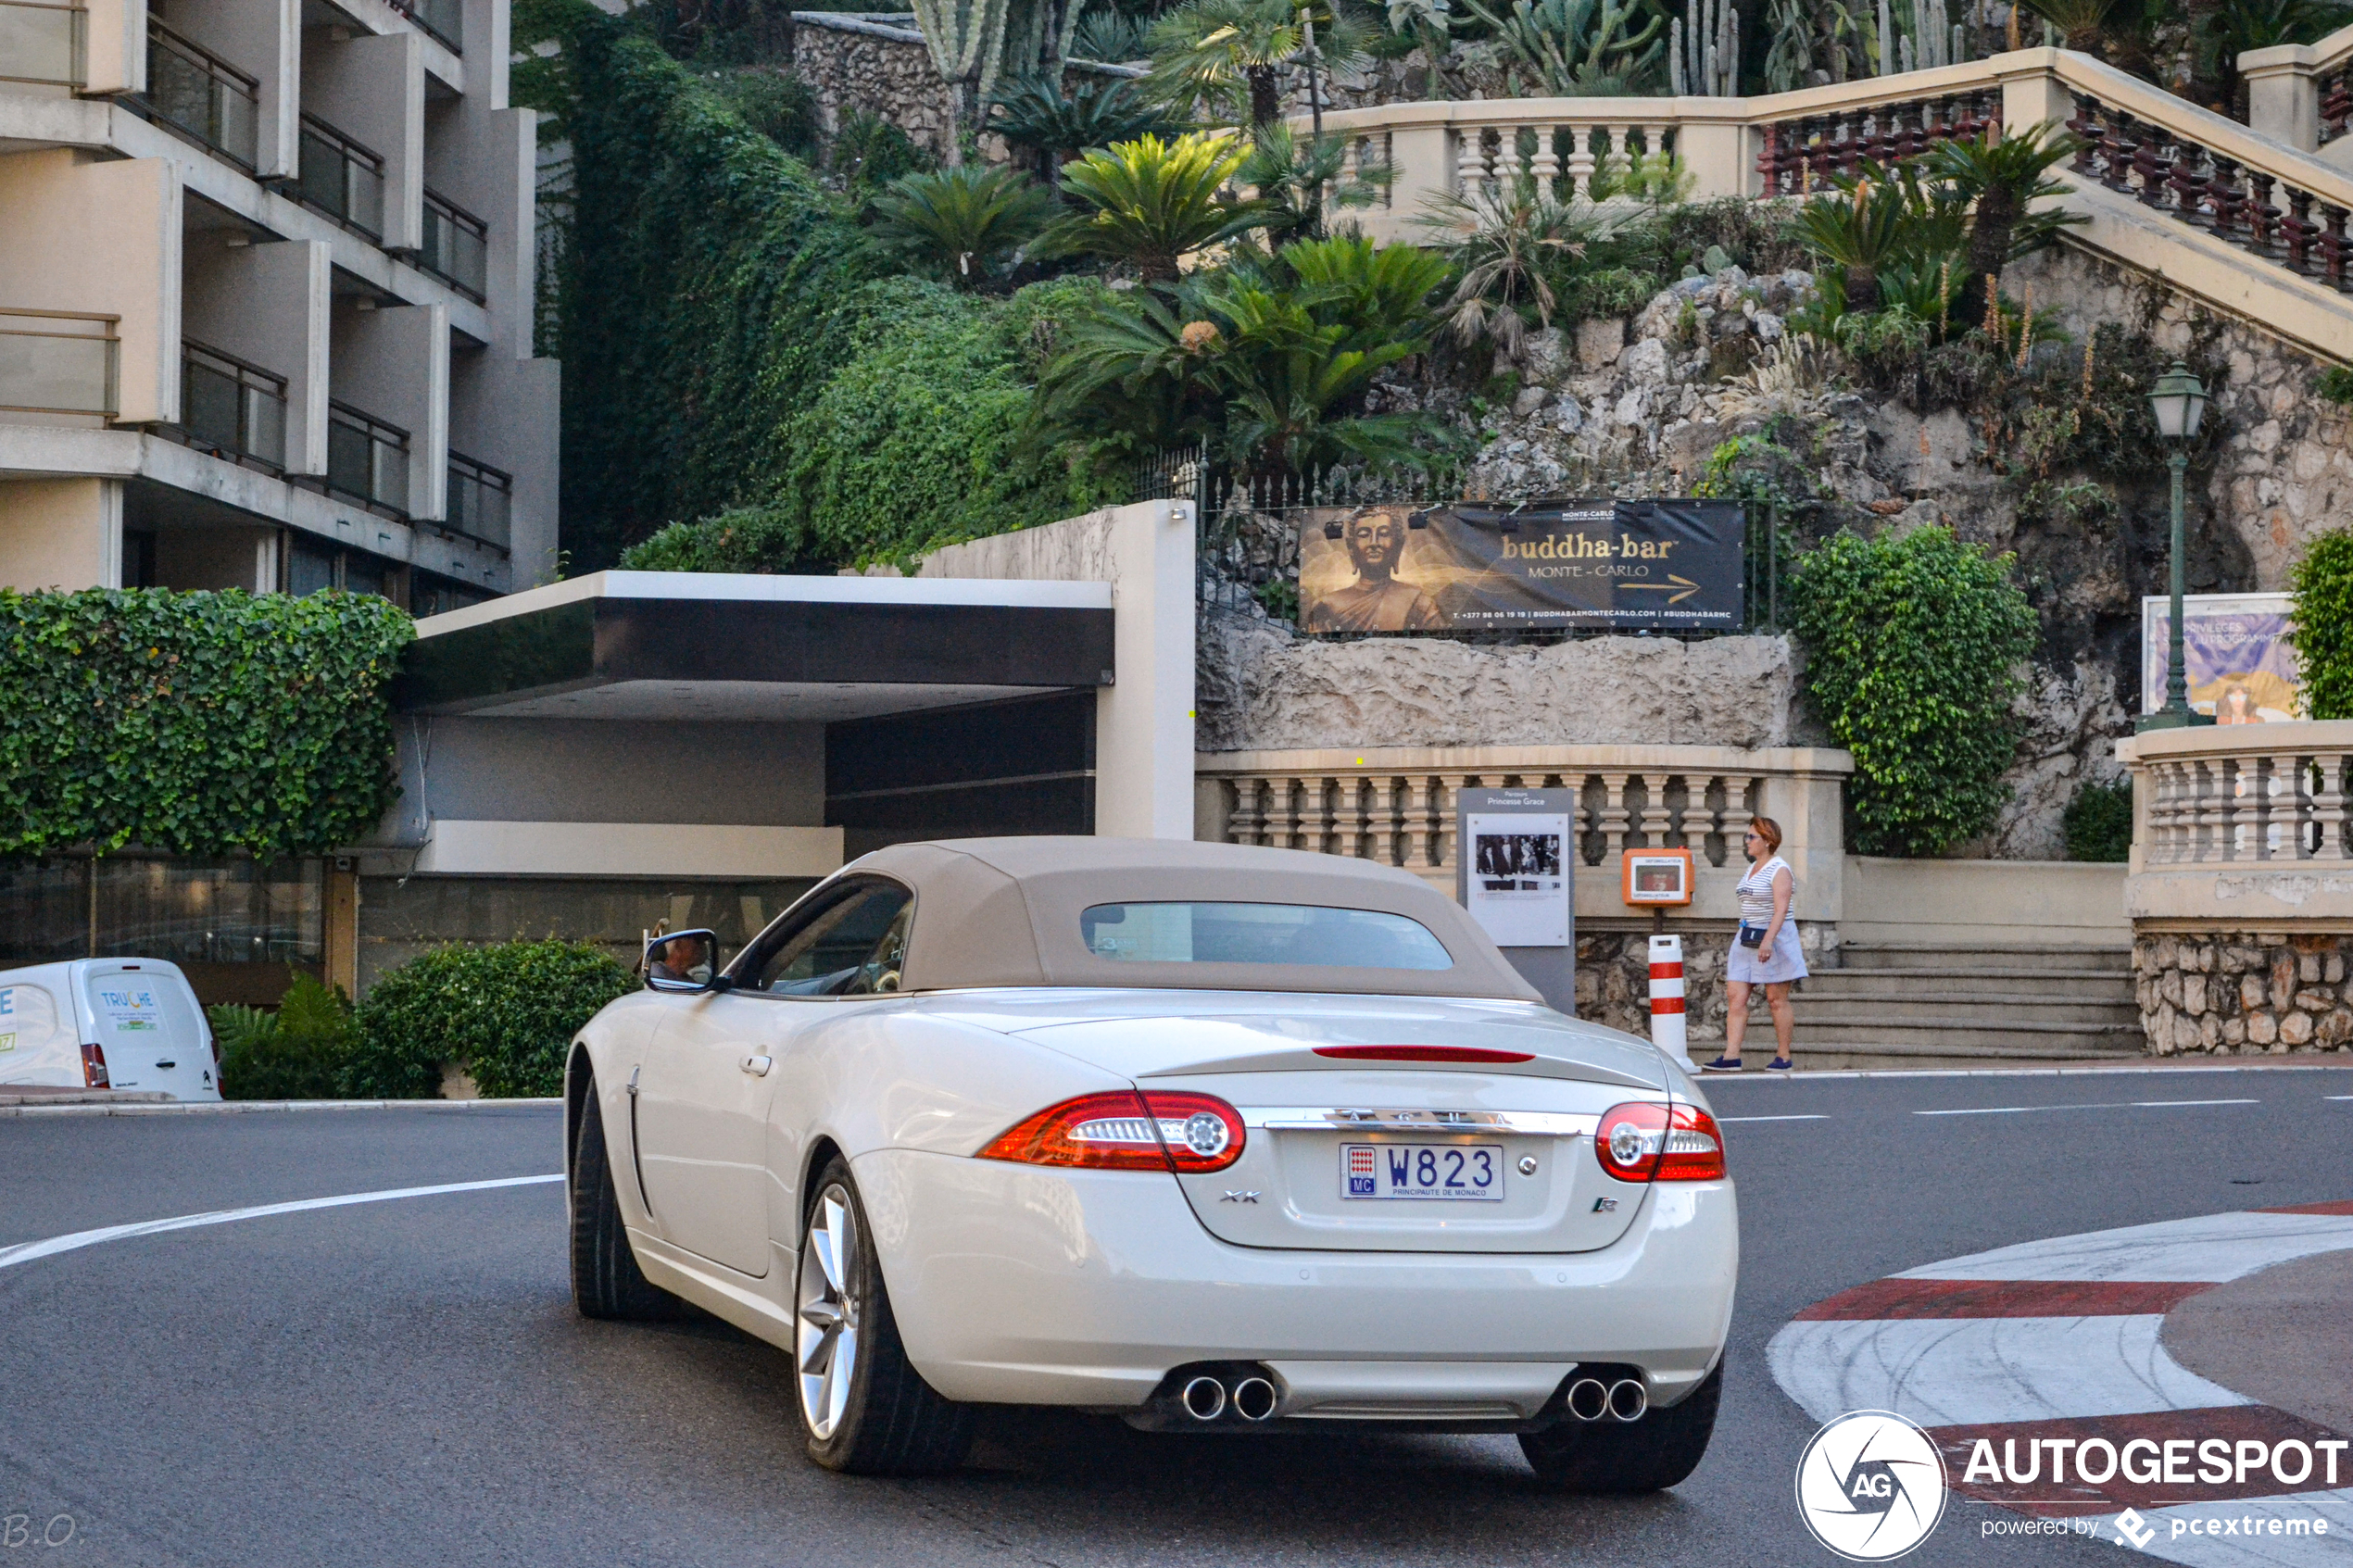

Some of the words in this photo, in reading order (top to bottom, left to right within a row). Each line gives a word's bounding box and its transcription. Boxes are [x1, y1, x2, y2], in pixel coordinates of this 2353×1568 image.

[1529, 566, 1582, 578] MONTE
[1595, 565, 1649, 578] CARLO
[1664, 610, 1731, 619] #BUDDHABARMC
[1487, 797, 1521, 806] Princesse
[1523, 797, 1545, 806] Grace
[101, 991, 154, 1009] TRUCHE
[1388, 1148, 1493, 1187] W823
[1353, 1179, 1372, 1193] MC
[1220, 1190, 1261, 1204] XK
